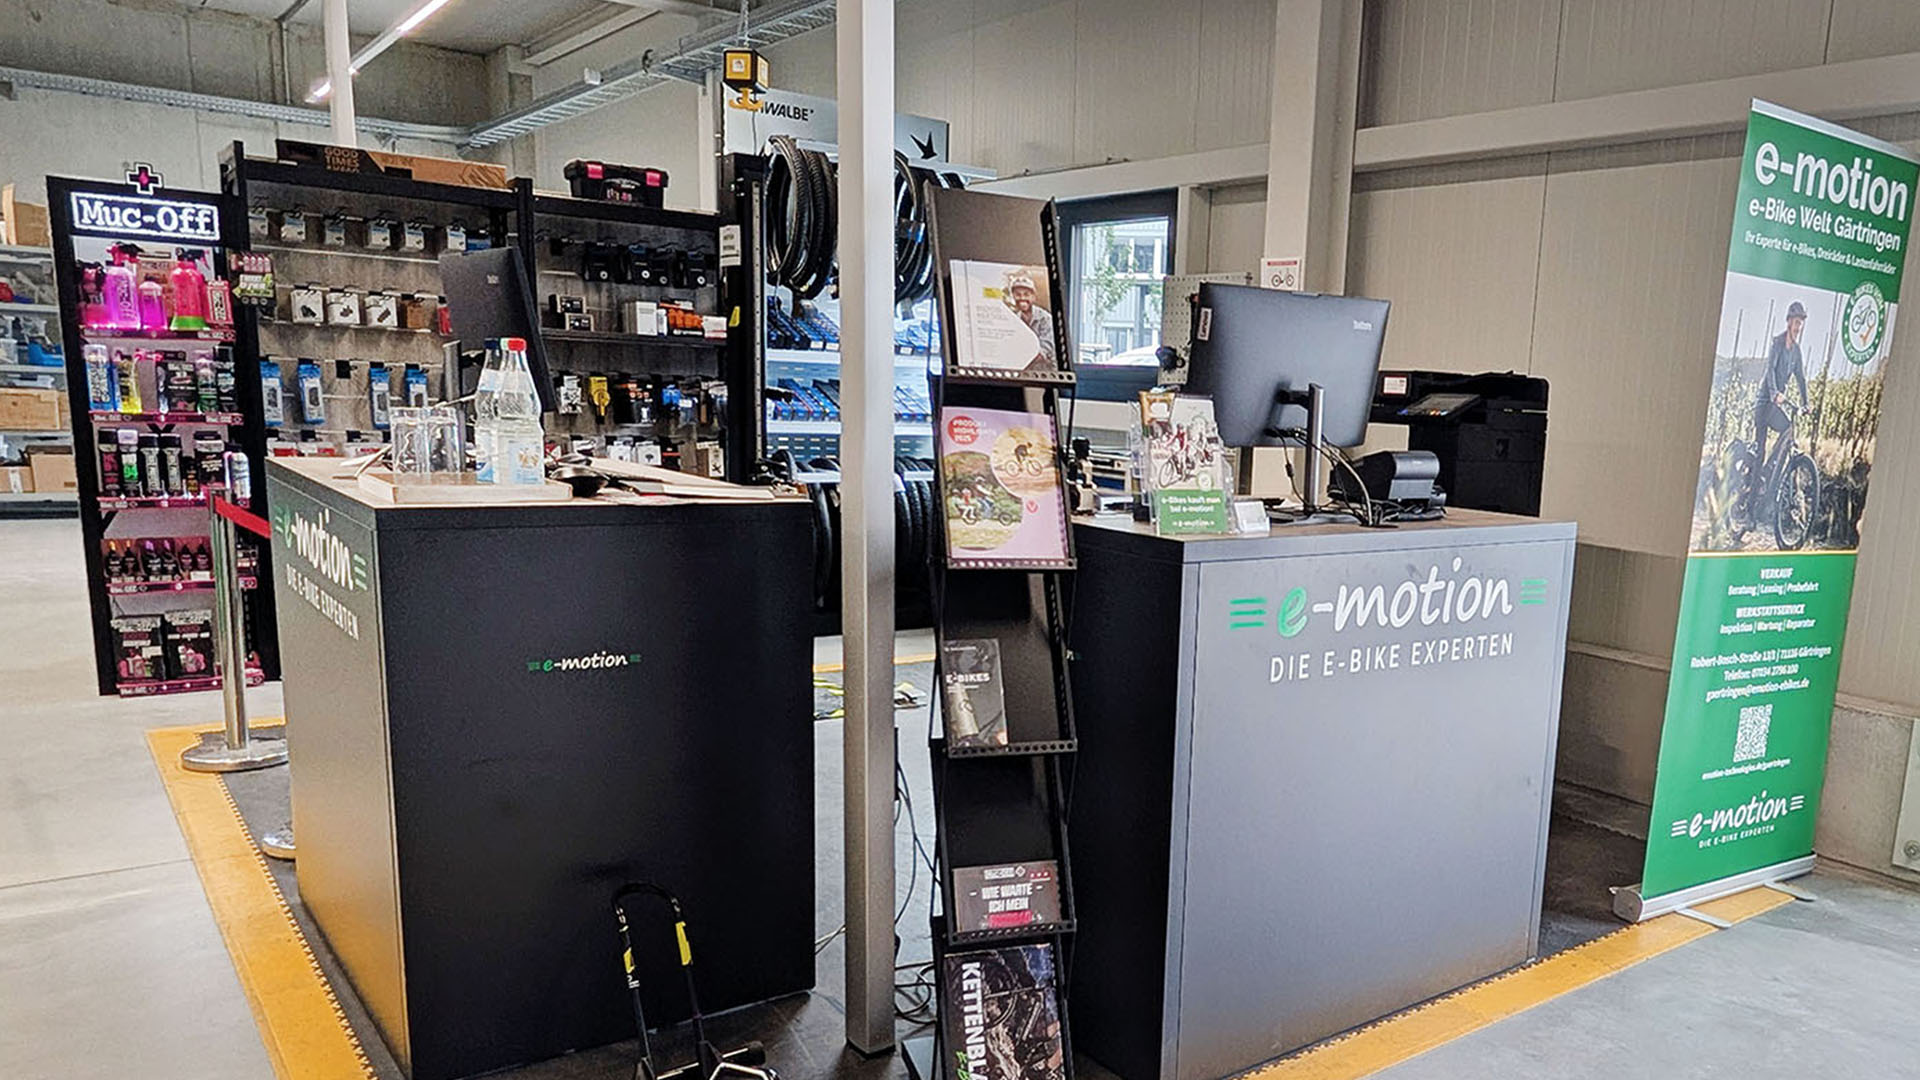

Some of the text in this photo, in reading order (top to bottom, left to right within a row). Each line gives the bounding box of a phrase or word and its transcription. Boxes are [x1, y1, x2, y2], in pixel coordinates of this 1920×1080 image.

[758, 99, 809, 121] WALBE
[324, 147, 358, 158] GOOD
[325, 156, 360, 168] TIMES
[1755, 142, 1908, 221] e-motion
[79, 199, 212, 235] Muc-Off
[1749, 198, 1901, 252] e-Bike Welt Gärtringen
[1744, 230, 1755, 243] Ihr
[1755, 233, 1781, 249] Experte
[1782, 239, 1792, 251] für
[1792, 242, 1816, 259] e-Bikes,
[284, 506, 354, 591] e-motion
[286, 563, 298, 591] DIE
[321, 589, 359, 641] EXPERTEN
[1276, 556, 1513, 638] e-motion
[543, 651, 629, 673] e-motion
[1270, 632, 1514, 683] DIE E-BIKE EXPERTEN
[945, 673, 991, 684] E-BIKES
[1689, 790, 1788, 838] e-motion
[1699, 825, 1775, 849] DIE E-BIKE EXPERTEN
[982, 883, 1033, 899] WIE WARTE
[989, 897, 1029, 912] ICH MEIN
